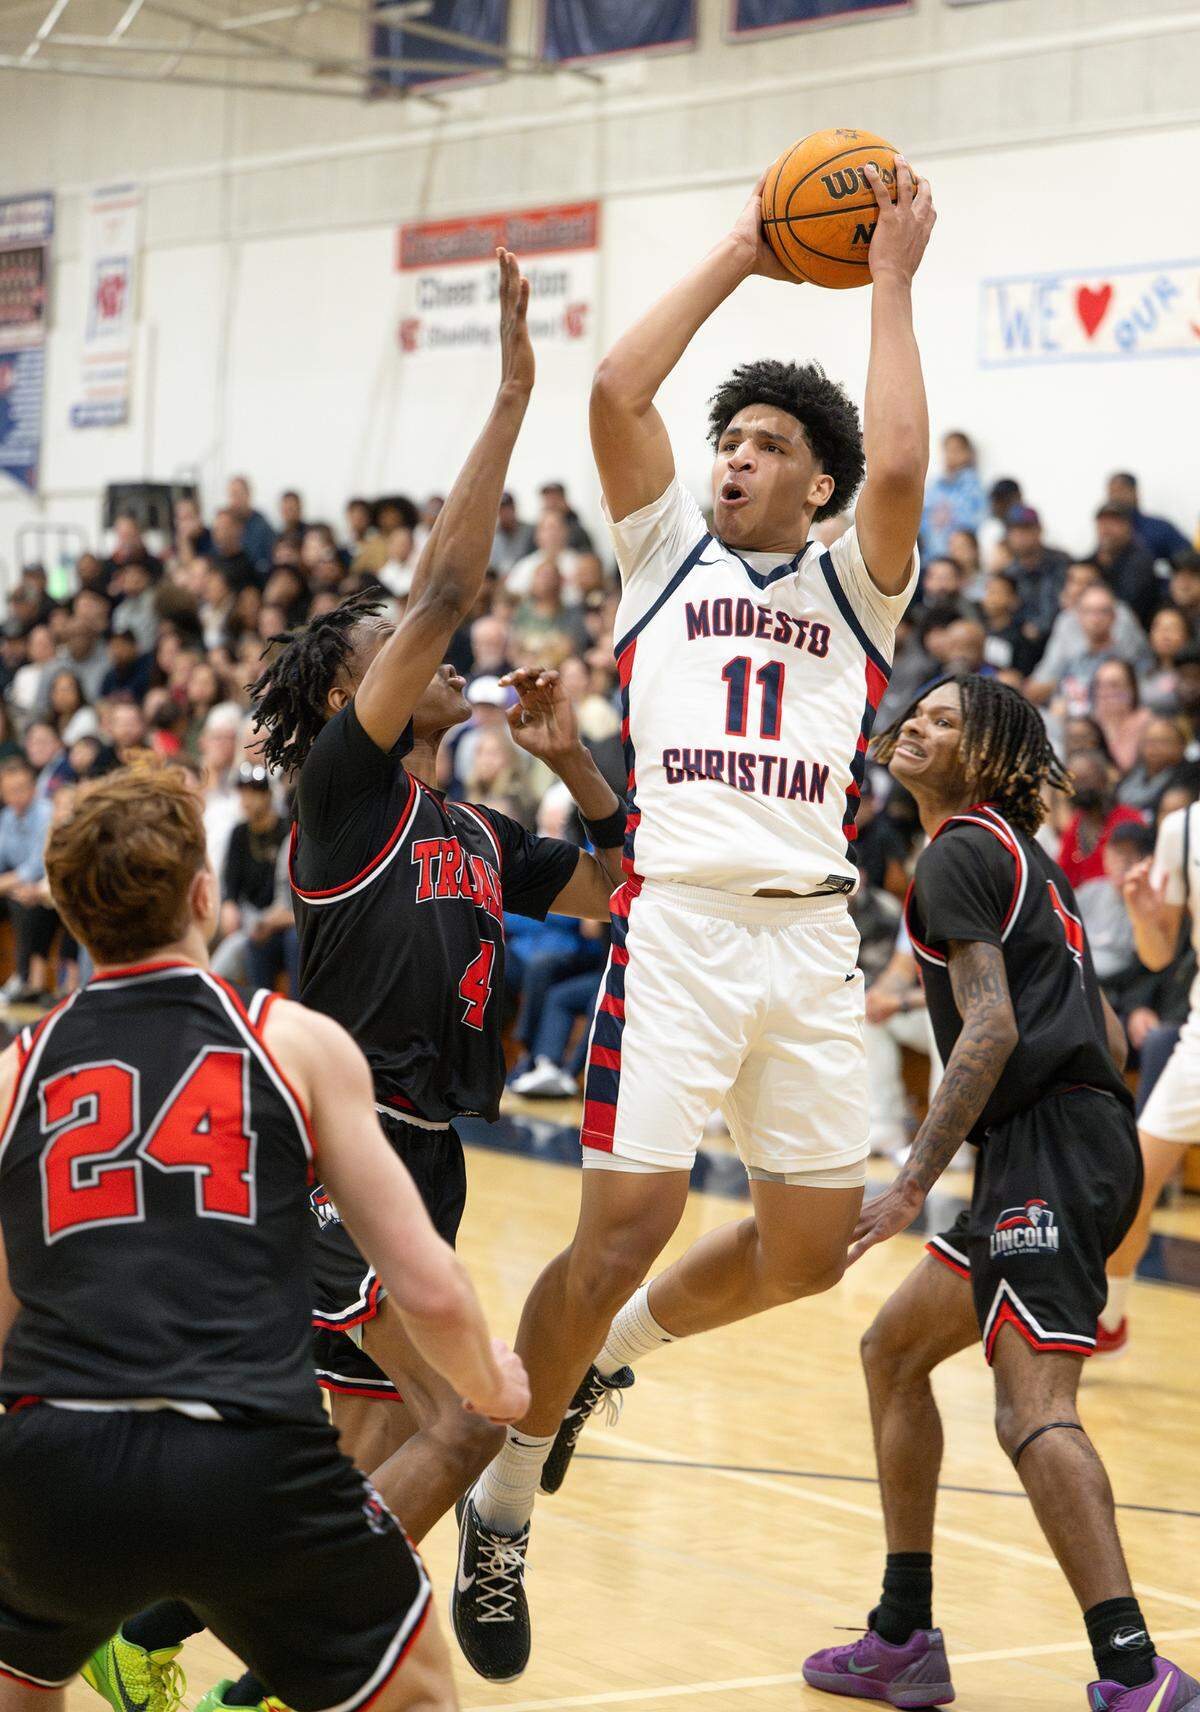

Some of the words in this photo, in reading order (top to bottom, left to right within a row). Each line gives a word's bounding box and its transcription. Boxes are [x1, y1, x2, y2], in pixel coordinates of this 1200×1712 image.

[486, 269, 568, 302] Stion
[996, 279, 1062, 351] WE
[1114, 274, 1181, 351] OUR
[685, 597, 831, 658] MODESTO
[721, 655, 785, 741] 11
[662, 748, 830, 804] CHRISTIAN
[459, 938, 496, 1031] 4
[37, 1044, 258, 1246] 24
[989, 1226, 1059, 1260] LINCOLN
